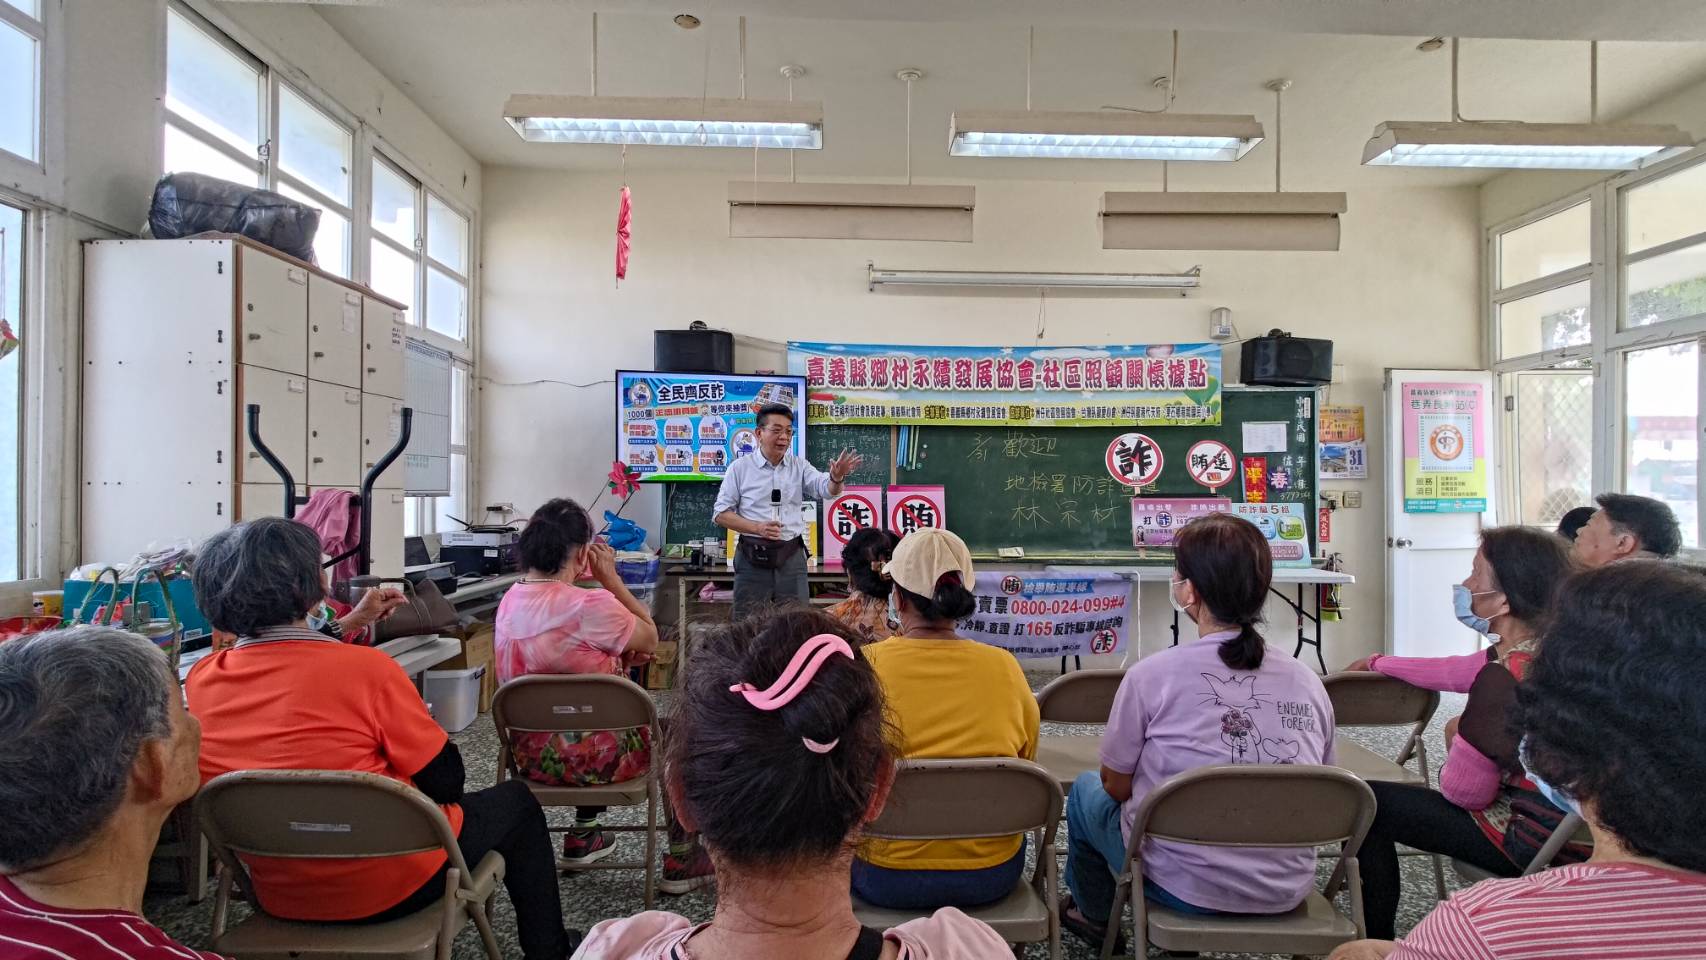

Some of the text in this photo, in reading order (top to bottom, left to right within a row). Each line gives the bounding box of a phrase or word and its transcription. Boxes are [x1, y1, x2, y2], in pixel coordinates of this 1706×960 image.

[807, 357, 1206, 389] 嘉義縣鄉村永續發展協會-社區照顧關懷據點
[658, 383, 723, 402] 全民齊反詐
[1002, 430, 1060, 458] 歡迎
[1115, 440, 1152, 476] 詐
[1191, 453, 1232, 472] 賄選
[1350, 449, 1363, 466] 31
[1271, 471, 1288, 489] 春
[838, 503, 870, 536] 詐
[902, 503, 934, 535] 賄
[974, 595, 1126, 615] 賣票 0800-024-099#4
[954, 619, 1010, 635] .冷靜.查證
